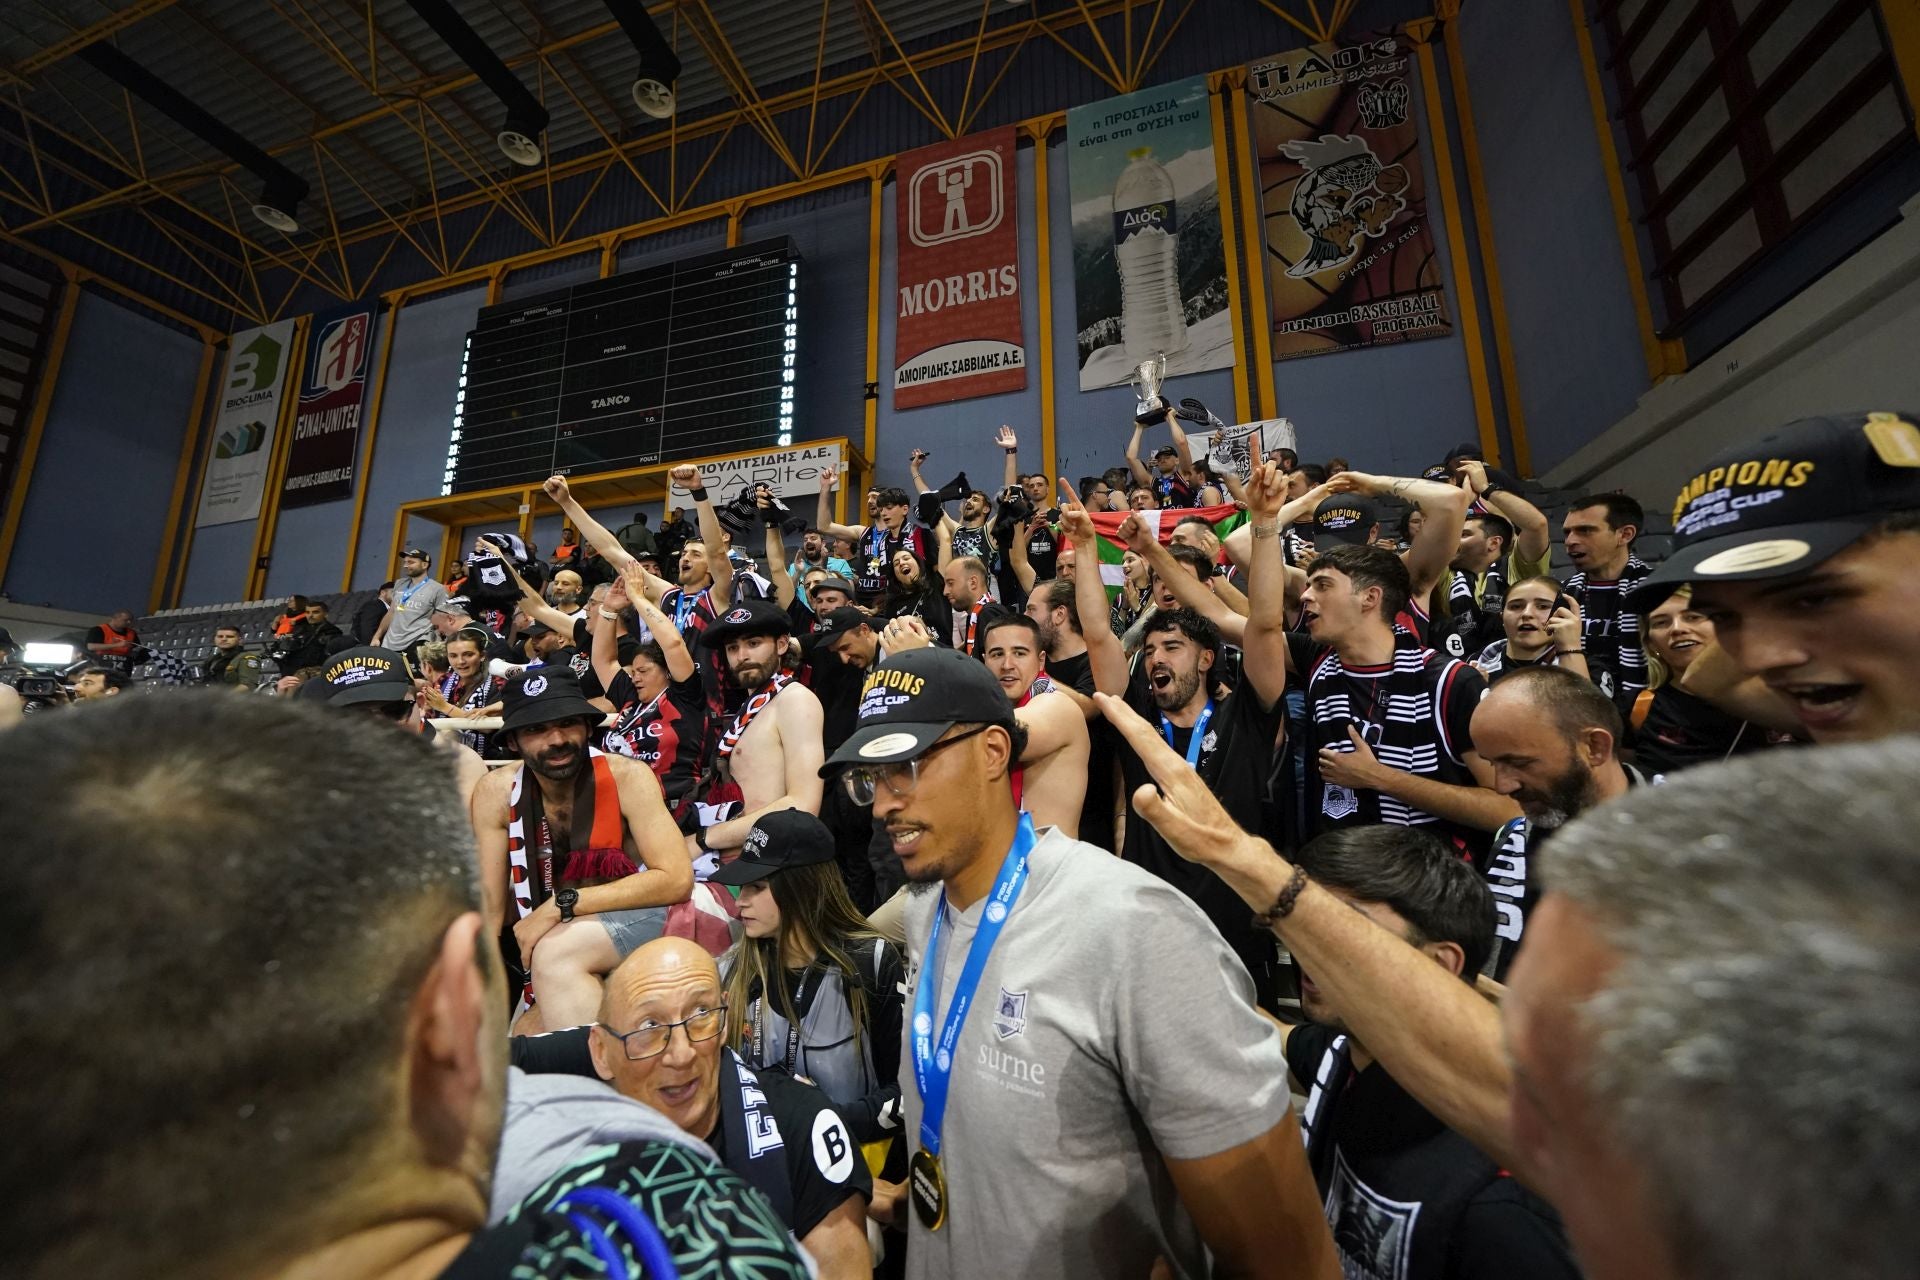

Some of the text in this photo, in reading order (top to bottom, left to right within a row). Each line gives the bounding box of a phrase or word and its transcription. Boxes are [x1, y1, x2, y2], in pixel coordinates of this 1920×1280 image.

[1104, 99, 1178, 127] ΠΡΟΣΤΑΣΙΑ
[1079, 110, 1200, 148] είναι στη ΦΥΣΗ του
[731, 256, 761, 269] PERSONAL
[759, 258, 779, 268] SCORE
[899, 264, 1019, 318] MORRIS
[785, 307, 798, 321] 11
[1280, 293, 1441, 335] JUNIOR BASKETBALL
[1371, 312, 1441, 336] PROGRAM
[784, 323, 798, 337] 12
[782, 353, 797, 367] 17
[898, 349, 1022, 385] ΑΜΟΙΡΙΔΗΣ-ΣΑΒΒΙΔΗΣ Α.Ε.
[226, 390, 273, 409] BIOCLIMA
[801, 446, 832, 461] Α.Ε.
[1729, 488, 1785, 510] CUP
[1318, 508, 1362, 524] CHAMPIONS
[1452, 639, 1462, 650] B
[325, 656, 391, 683] CHAMPIONS
[333, 670, 365, 685] EUROPE
[884, 695, 911, 706] CUP
[544, 856, 553, 892] HIRUKOA
[1002, 856, 1026, 903] EUROPE CUP
[947, 995, 967, 1049] EUROPE CUP
[916, 1036, 925, 1074] EUROPE
[978, 1043, 1046, 1085] surne
[820, 1124, 846, 1167] B
